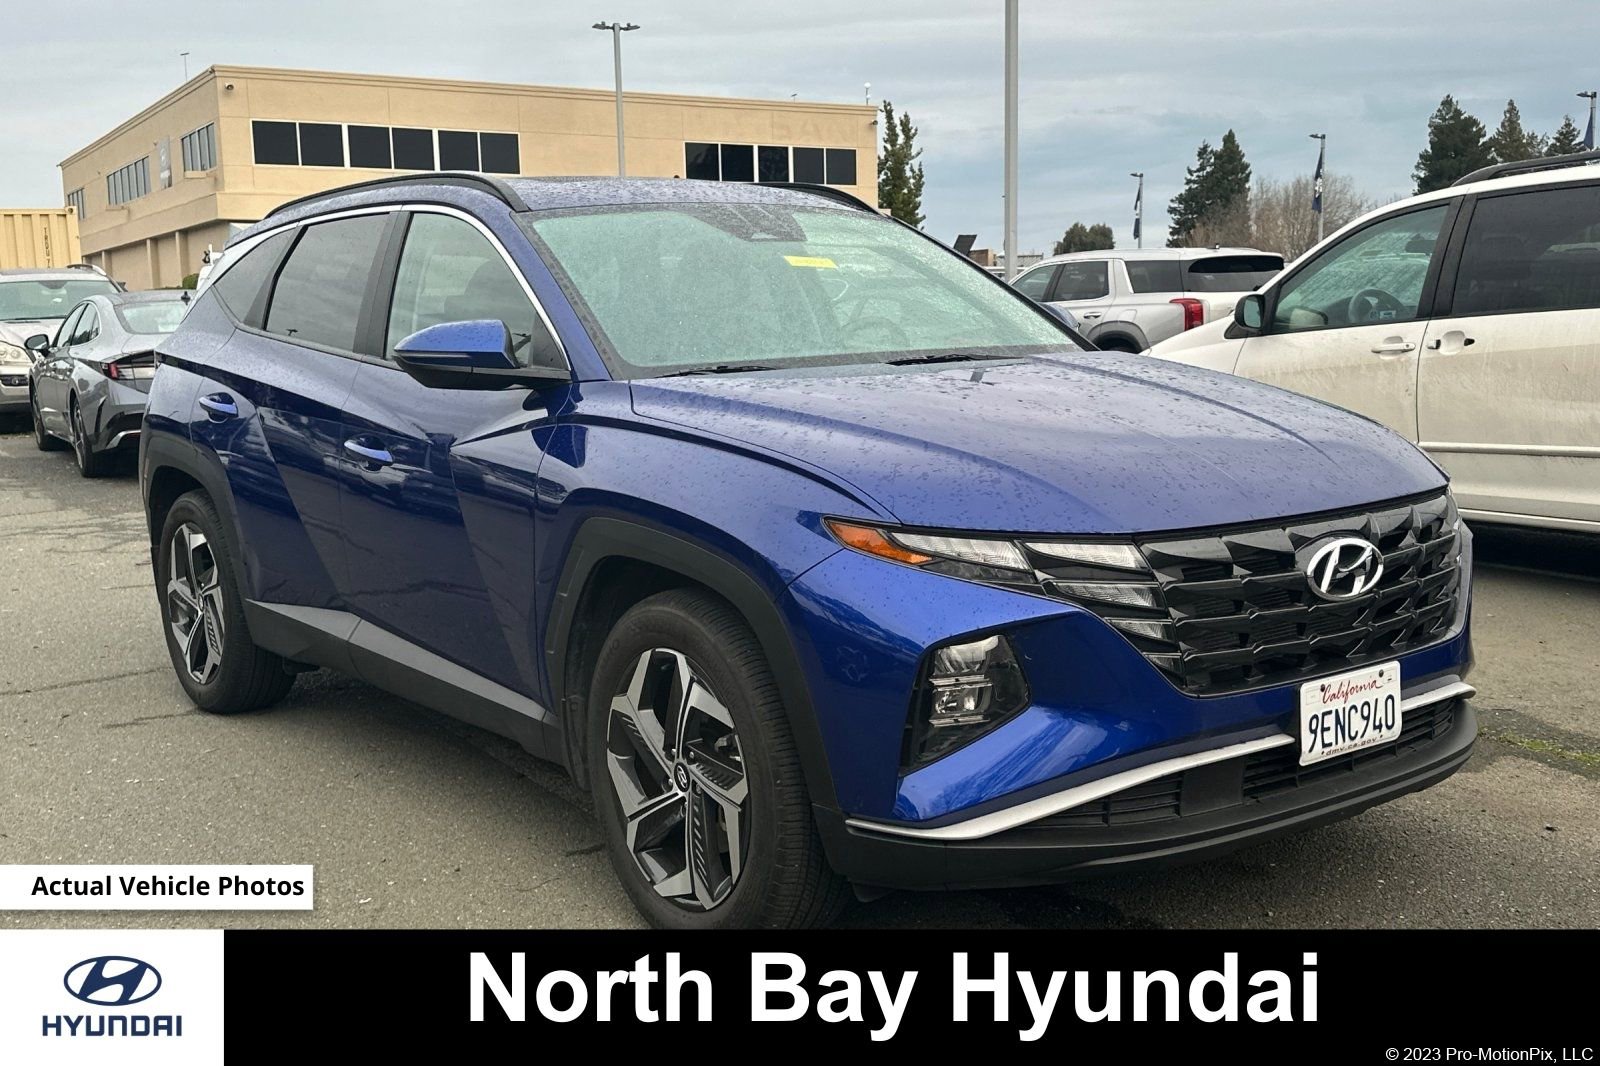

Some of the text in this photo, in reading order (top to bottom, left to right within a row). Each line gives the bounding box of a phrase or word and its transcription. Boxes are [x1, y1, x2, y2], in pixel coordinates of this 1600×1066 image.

[1322, 680, 1383, 704] California
[1308, 694, 1396, 753] 9ENC940
[1326, 738, 1377, 756] dmv.ca.gov
